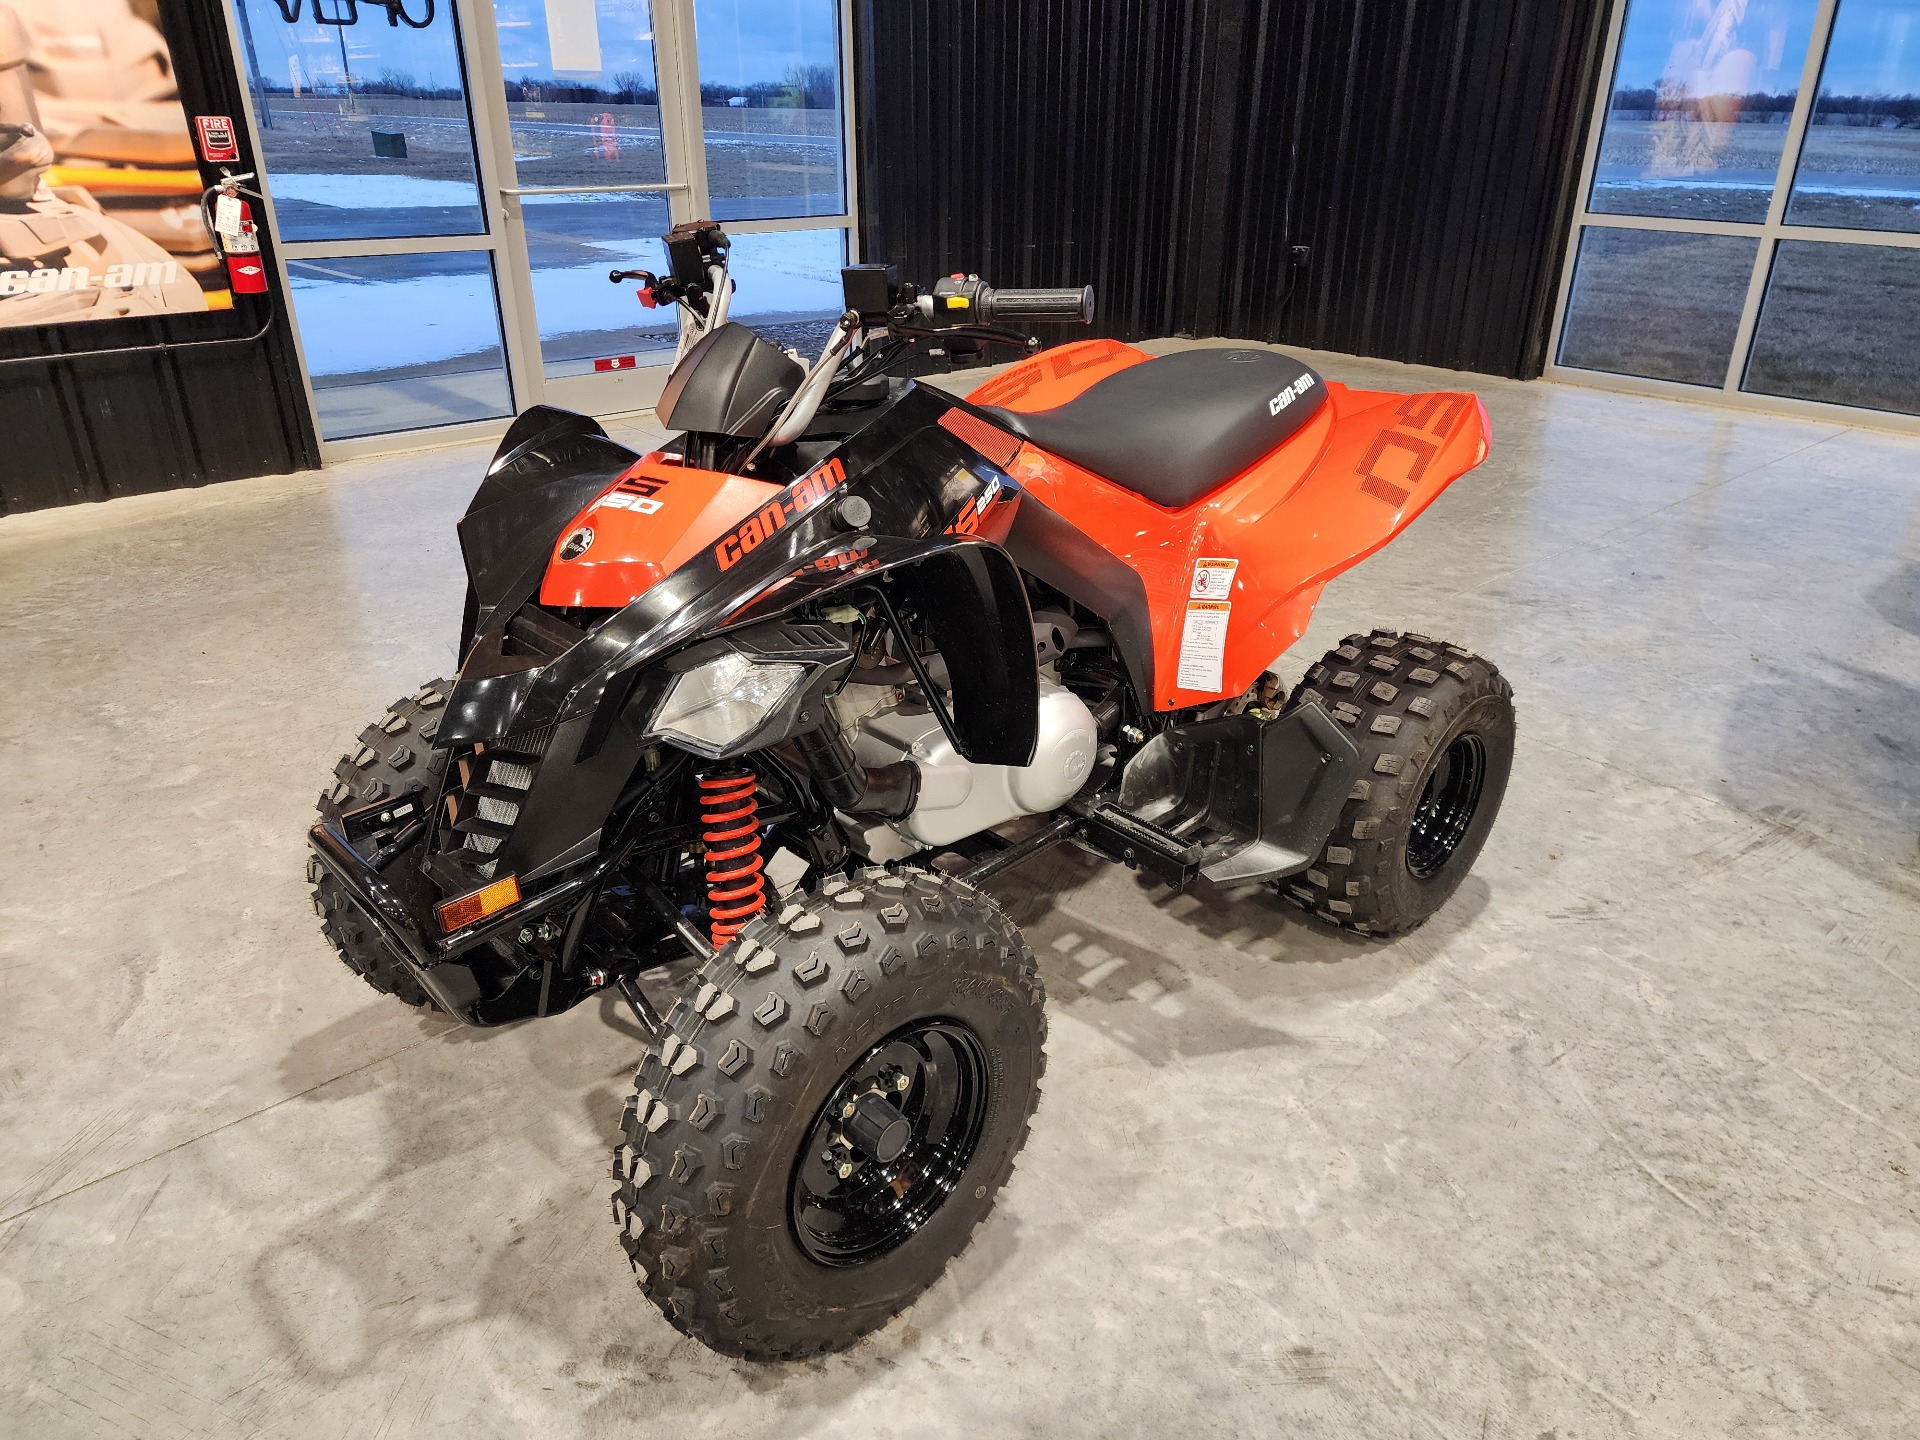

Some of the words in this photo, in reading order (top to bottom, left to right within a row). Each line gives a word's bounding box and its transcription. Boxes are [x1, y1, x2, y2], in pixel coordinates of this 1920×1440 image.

[202, 119, 229, 128] FIRE
[0, 261, 178, 295] can-am
[1269, 373, 1315, 416] can-am
[976, 475, 1001, 516] 250
[714, 457, 847, 573] can-am
[567, 542, 585, 553] BRP
